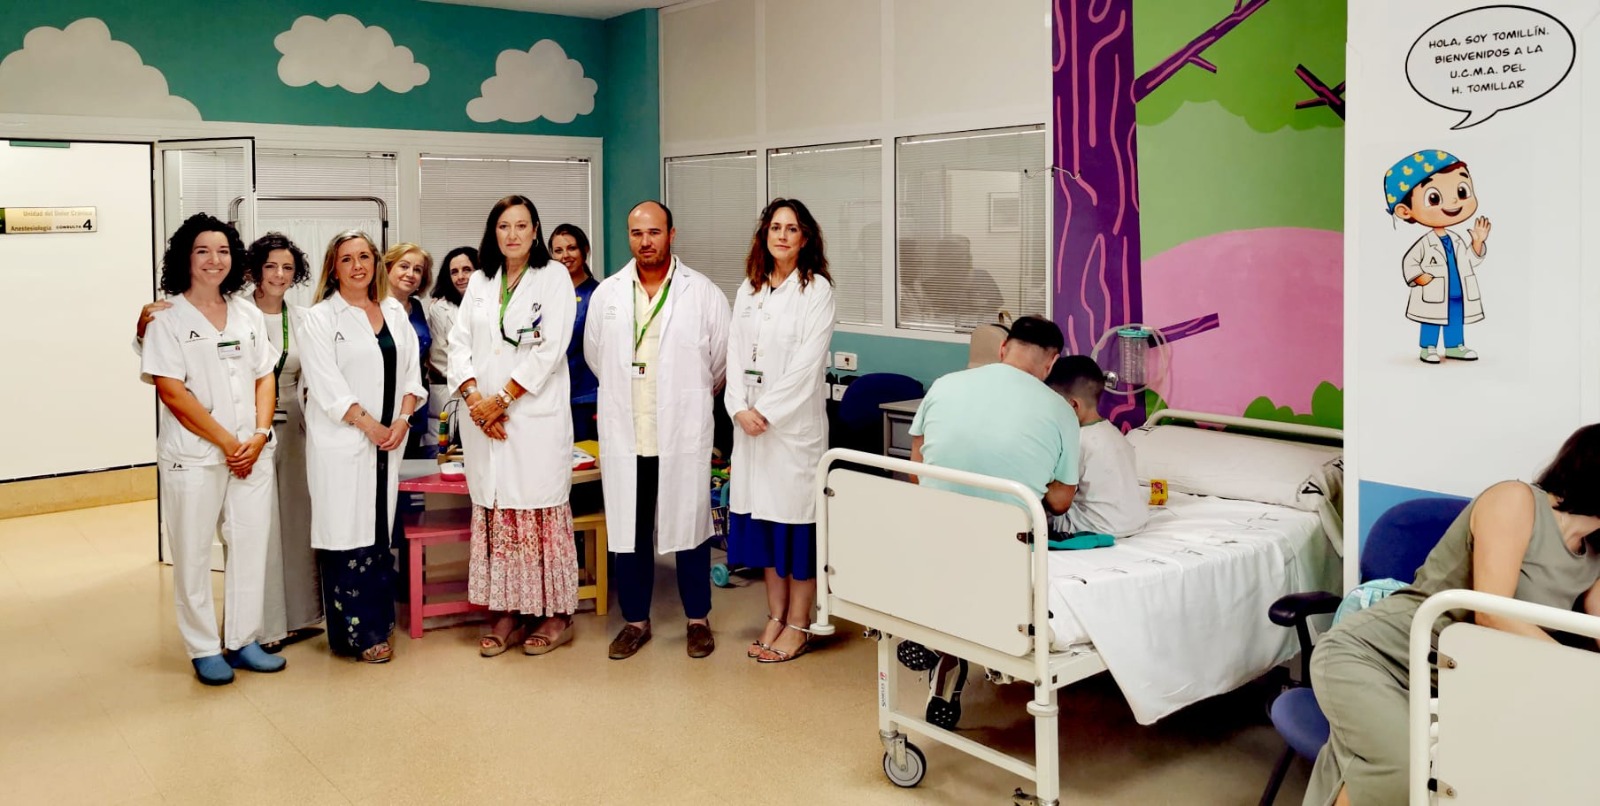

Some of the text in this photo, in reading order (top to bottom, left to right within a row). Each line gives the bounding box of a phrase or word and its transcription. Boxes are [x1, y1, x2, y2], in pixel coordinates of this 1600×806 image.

[1428, 25, 1550, 49] HOLA, SOY TOMILLÍN.
[1435, 44, 1543, 64] BIENVENIDOS A LA
[1450, 63, 1526, 79] U.C.M.A. DEL
[1451, 79, 1525, 95] H. TOMILLAR
[83, 219, 93, 230] 4
